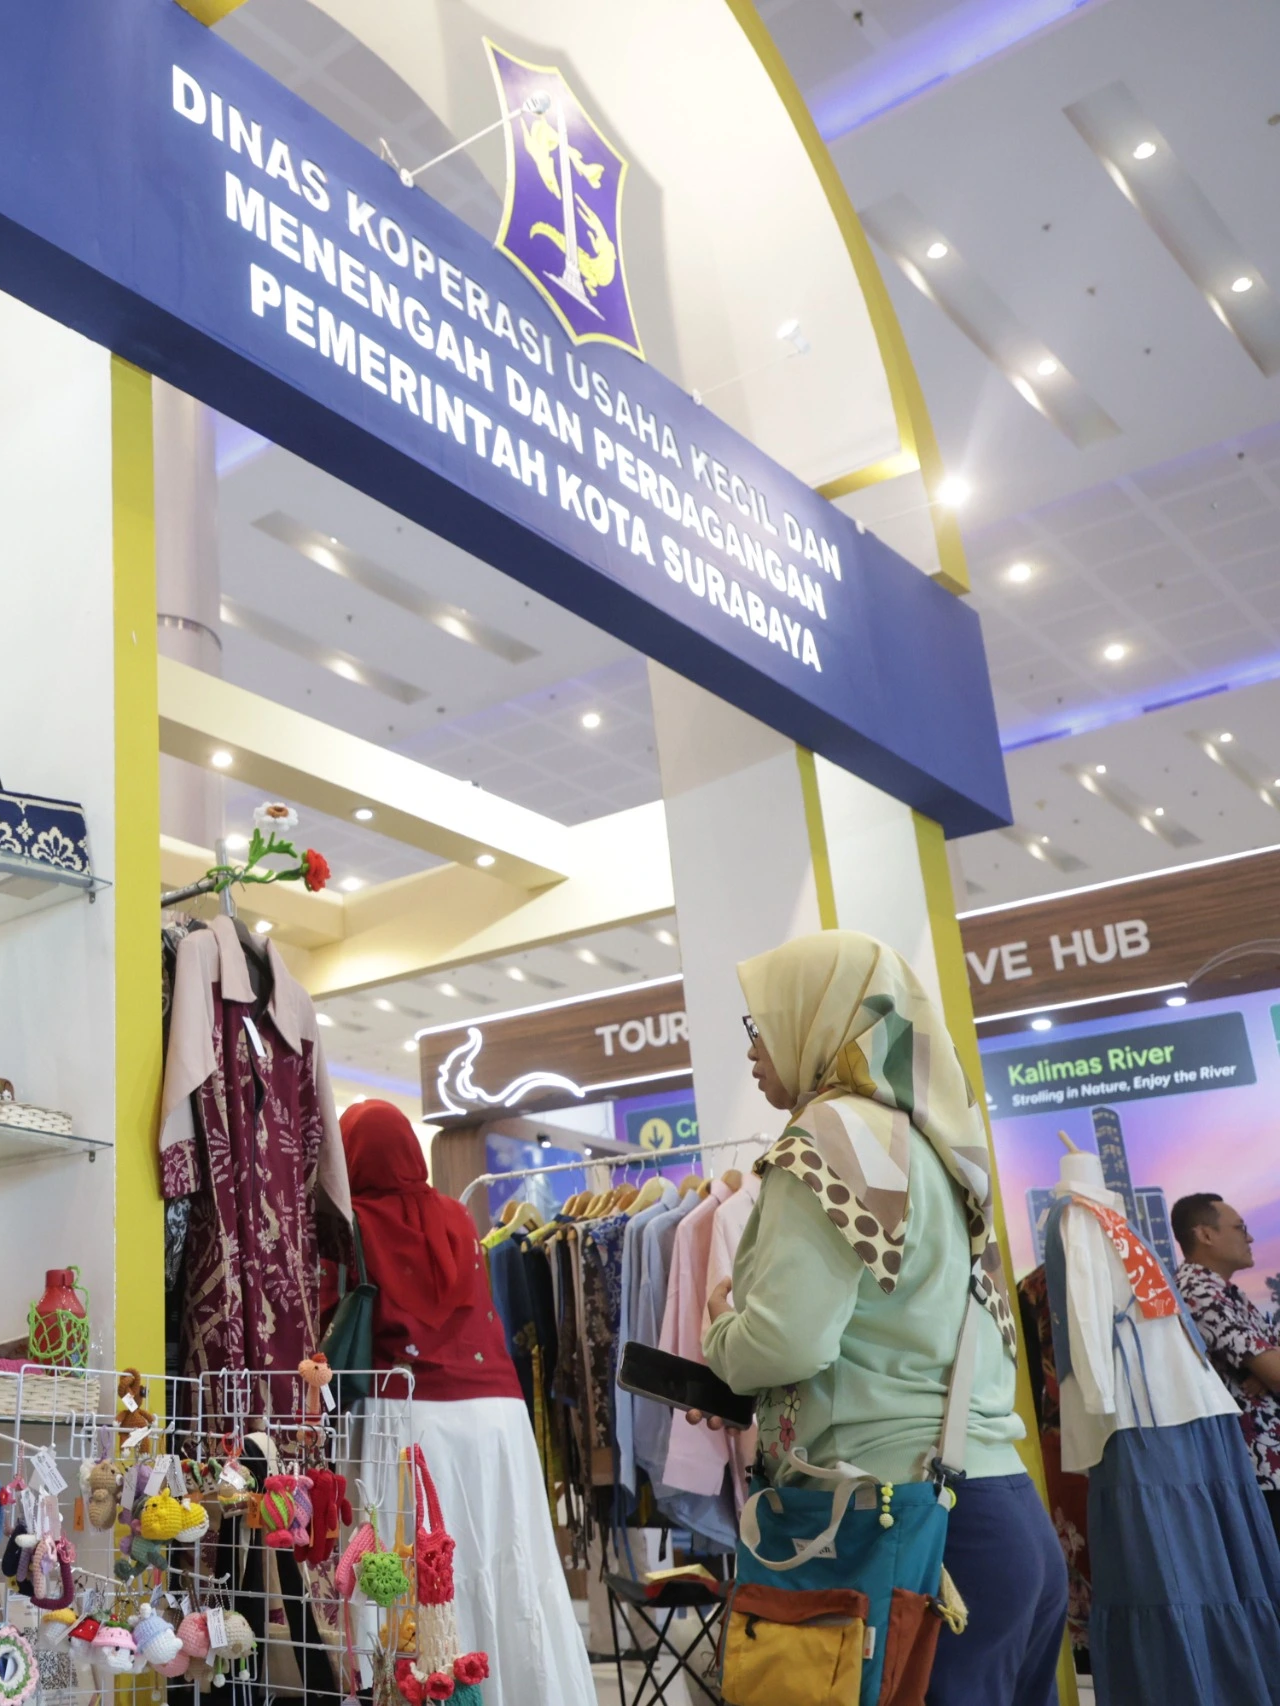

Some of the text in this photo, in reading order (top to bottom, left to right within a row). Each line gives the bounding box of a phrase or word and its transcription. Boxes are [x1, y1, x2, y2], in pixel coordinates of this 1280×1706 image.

[172, 64, 841, 581] DINAS KOPERASI USAHA KECIL DAN
[225, 171, 827, 620] MENENGAH DAN PERDAGANGAN
[250, 263, 822, 673] PEMERINTAH KOTA SURABAYA
[1050, 919, 1150, 971] HUB
[1008, 1043, 1175, 1087] Kalimas River
[1012, 1063, 1237, 1108] Strolling in Nature, Enjoy the River
